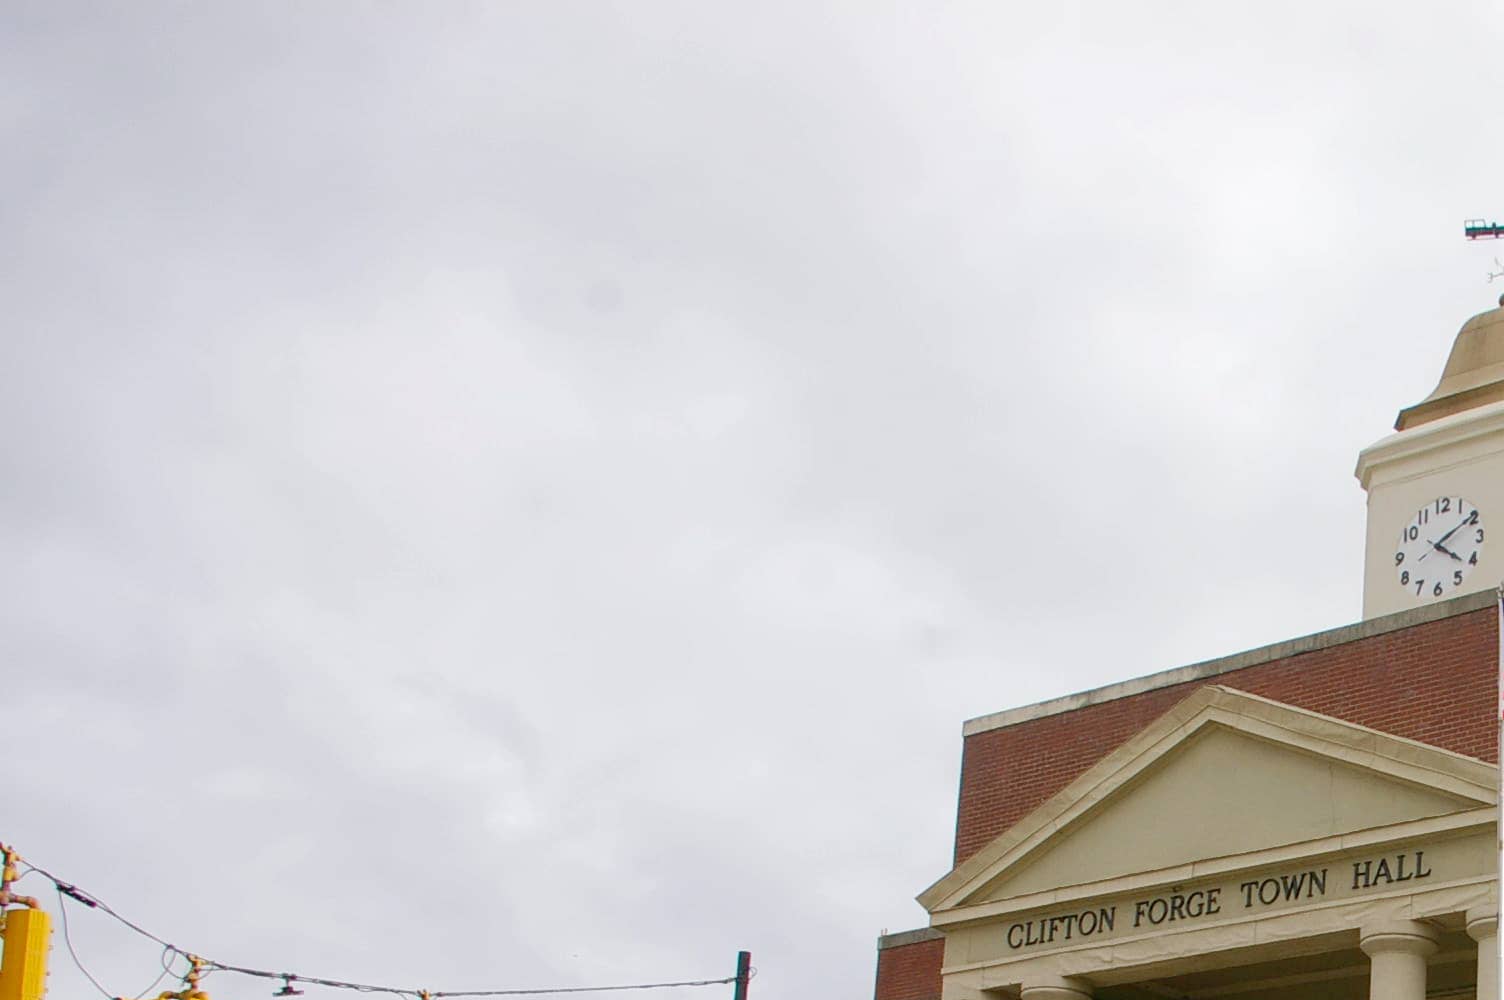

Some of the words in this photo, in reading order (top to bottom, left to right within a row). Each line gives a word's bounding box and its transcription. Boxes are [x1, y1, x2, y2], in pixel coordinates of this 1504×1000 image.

[1435, 497, 1450, 513] 12
[1417, 509, 1429, 525] 11
[1469, 510, 1479, 525] 2
[1403, 526, 1418, 542] 10
[1475, 529, 1484, 543] 3
[1395, 552, 1405, 566] 9
[1468, 551, 1478, 566] 4
[1400, 571, 1410, 585] 8
[1453, 571, 1463, 586] 5
[1415, 580, 1425, 596] 7
[1433, 581, 1443, 596] 6
[1006, 906, 1117, 950] CLIFTON
[1132, 888, 1222, 929] FORGE
[1240, 868, 1329, 909] TOWN
[1351, 851, 1432, 889] HALL
